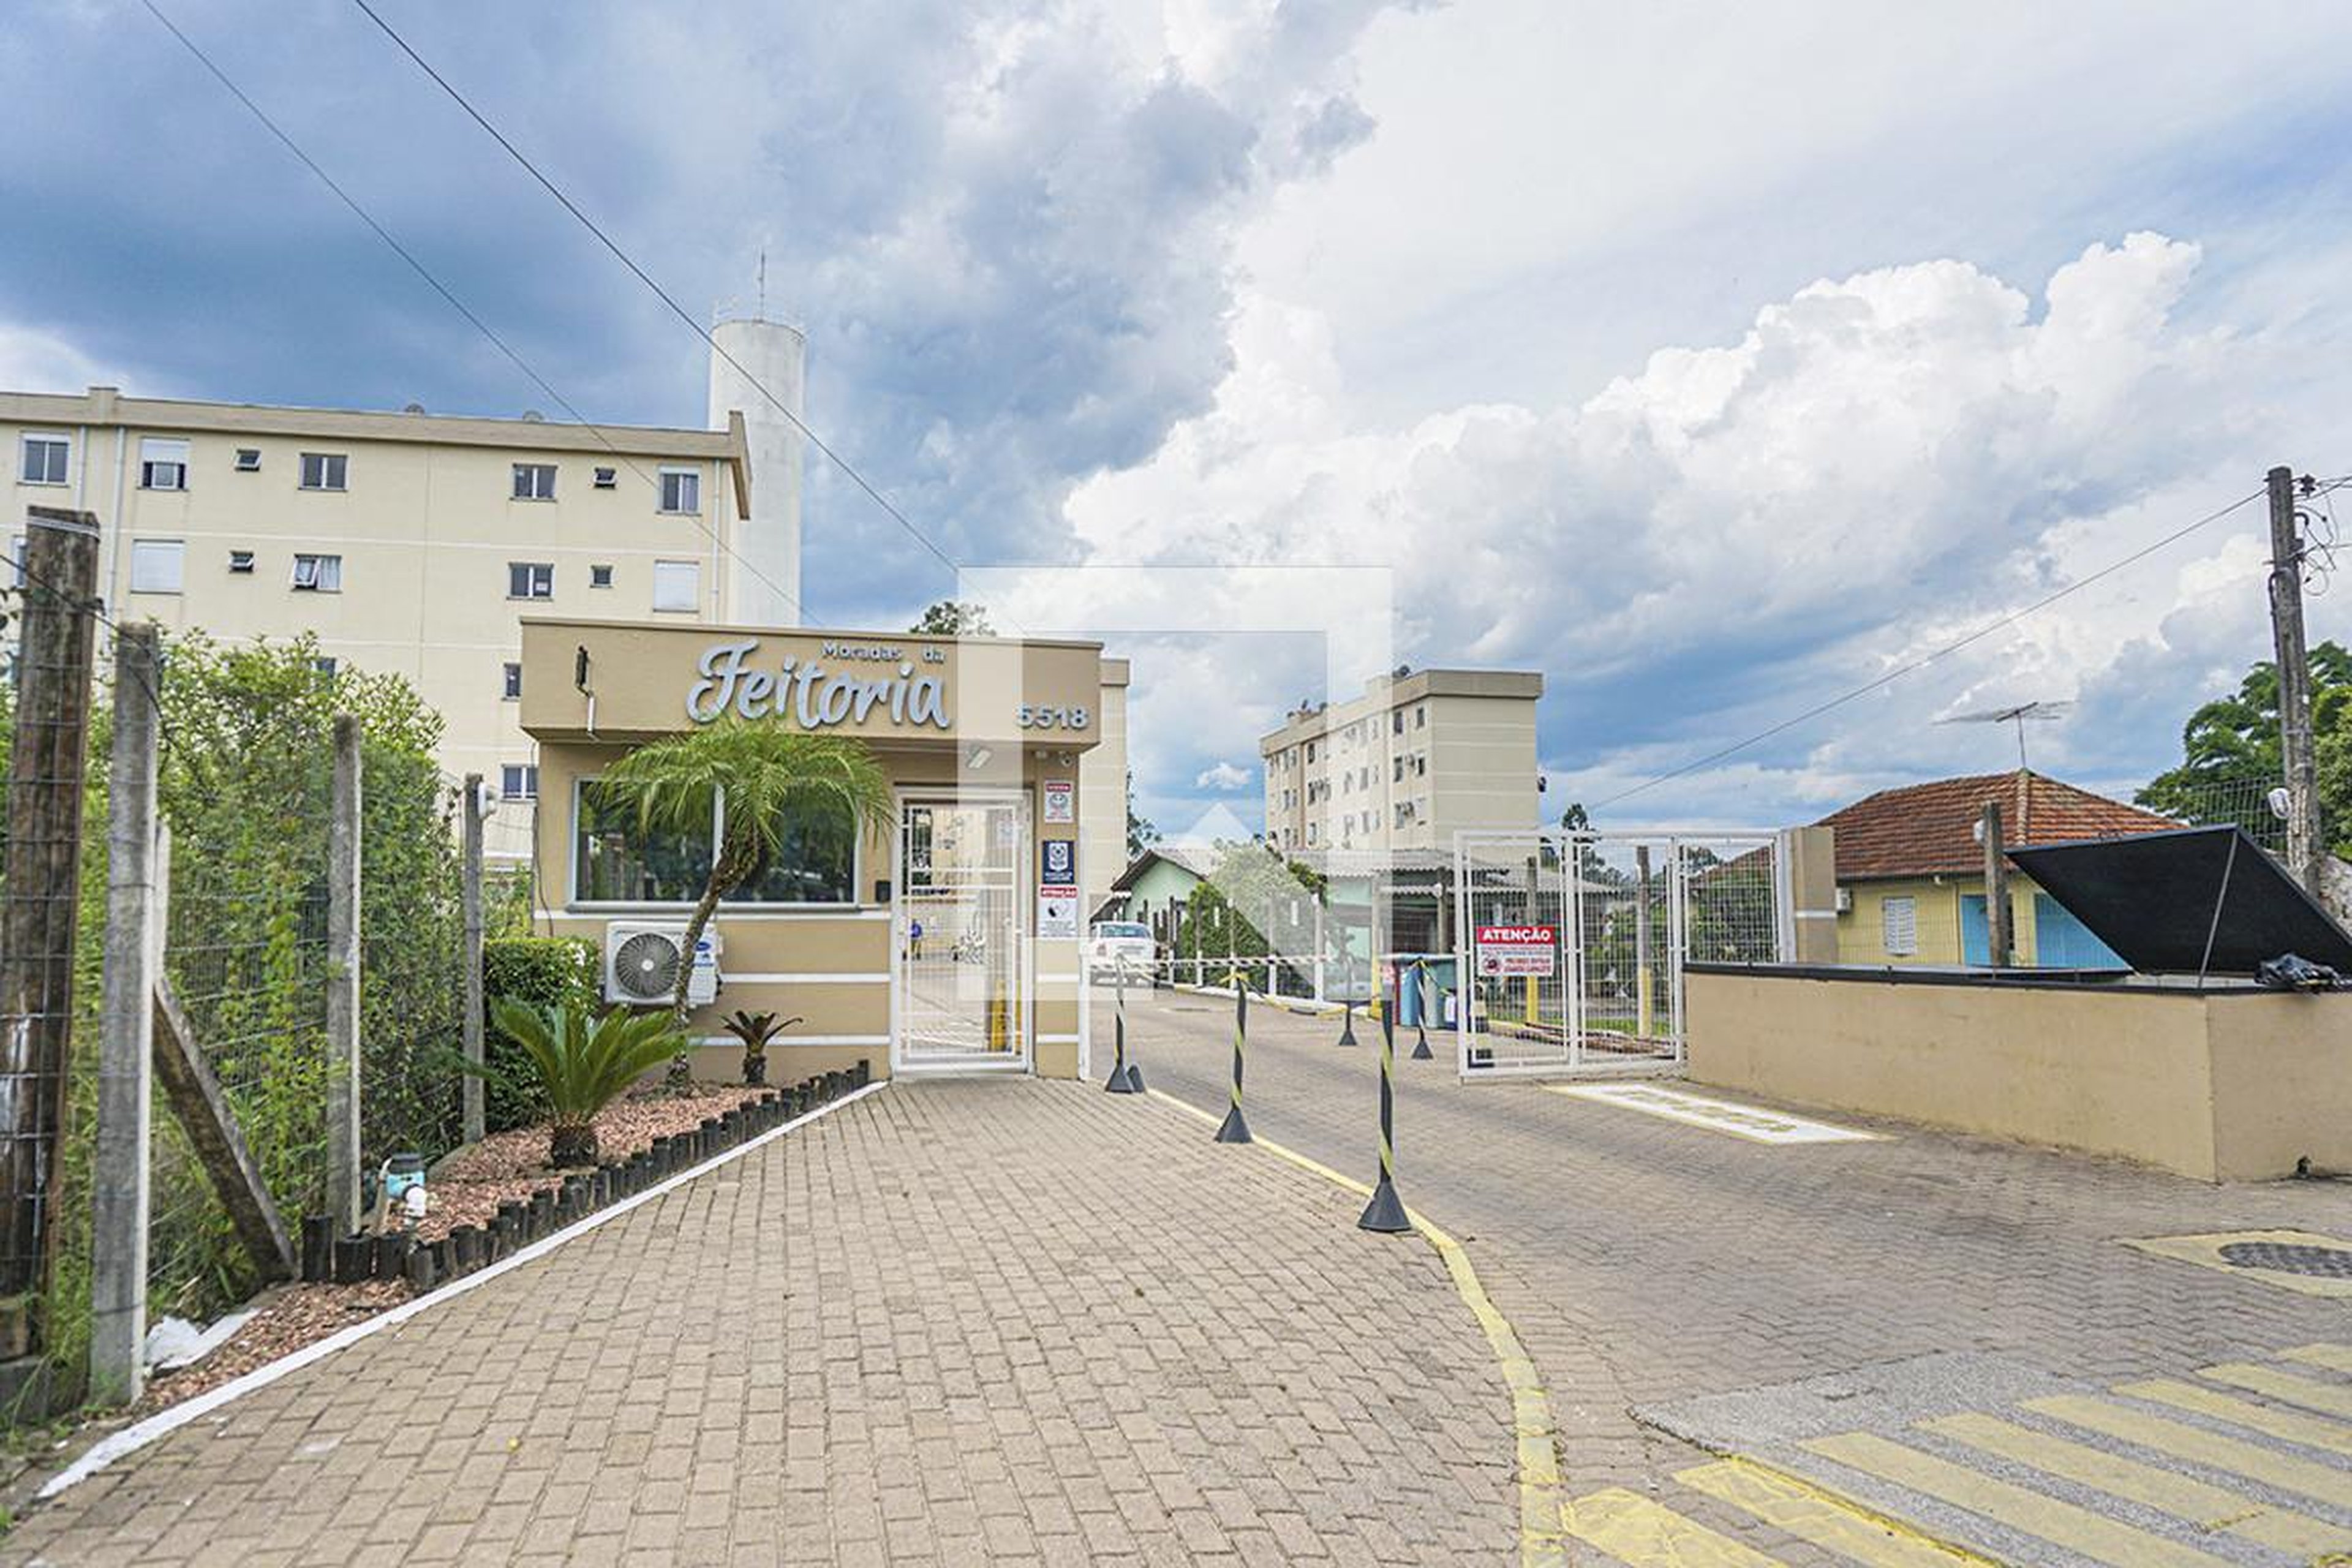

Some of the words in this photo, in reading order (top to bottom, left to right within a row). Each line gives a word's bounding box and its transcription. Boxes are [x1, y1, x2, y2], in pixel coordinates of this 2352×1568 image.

[822, 641, 902, 662] Moradas
[922, 645, 944, 663] da
[687, 638, 949, 729] Feitoria
[1016, 702, 1088, 729] 5518
[1482, 927, 1551, 943] ATENÇÃO
